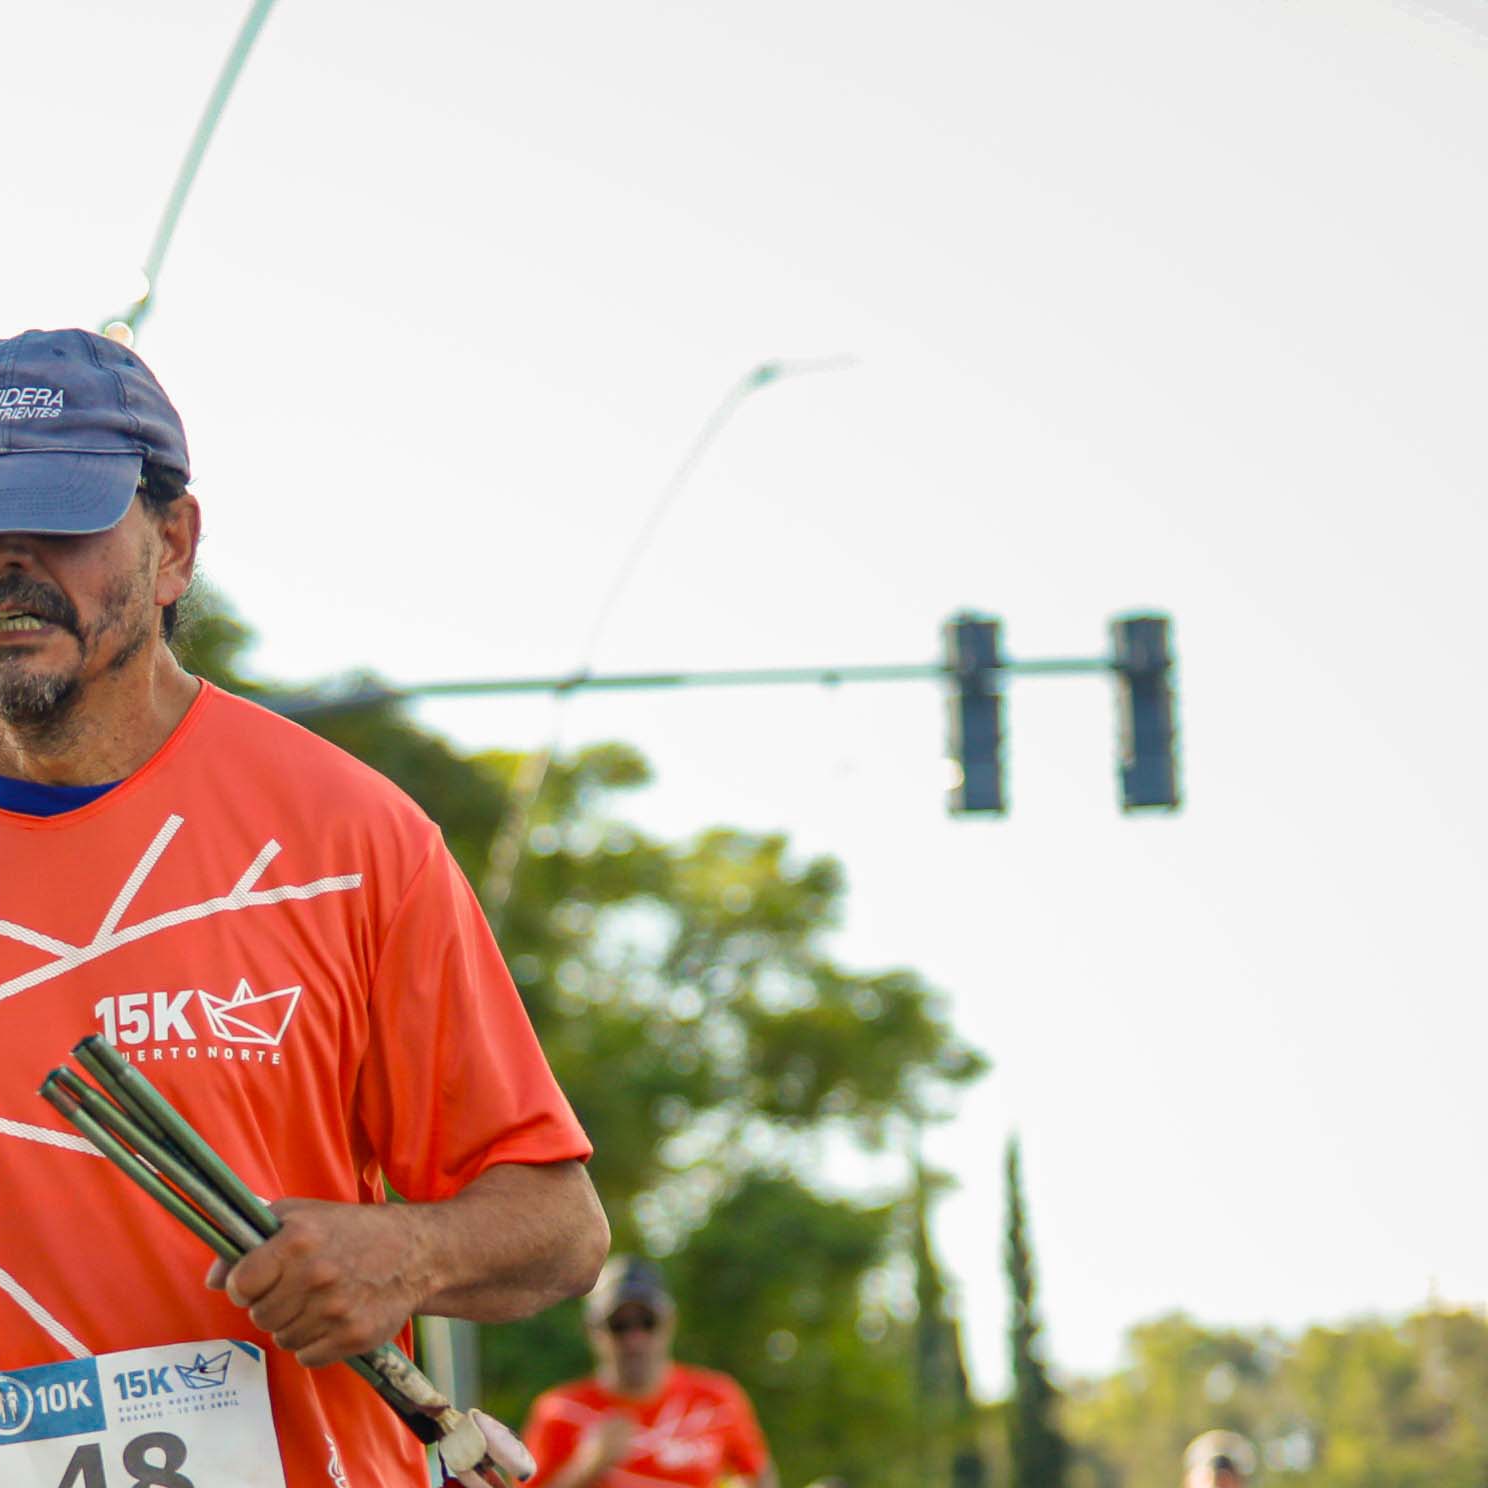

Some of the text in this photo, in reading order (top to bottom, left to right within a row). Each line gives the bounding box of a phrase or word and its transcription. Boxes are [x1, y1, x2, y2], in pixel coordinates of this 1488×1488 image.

[94, 989, 197, 1046] 15K
[121, 1046, 281, 1065] UERTO NORTE
[35, 1365, 174, 1415] 10K 15K
